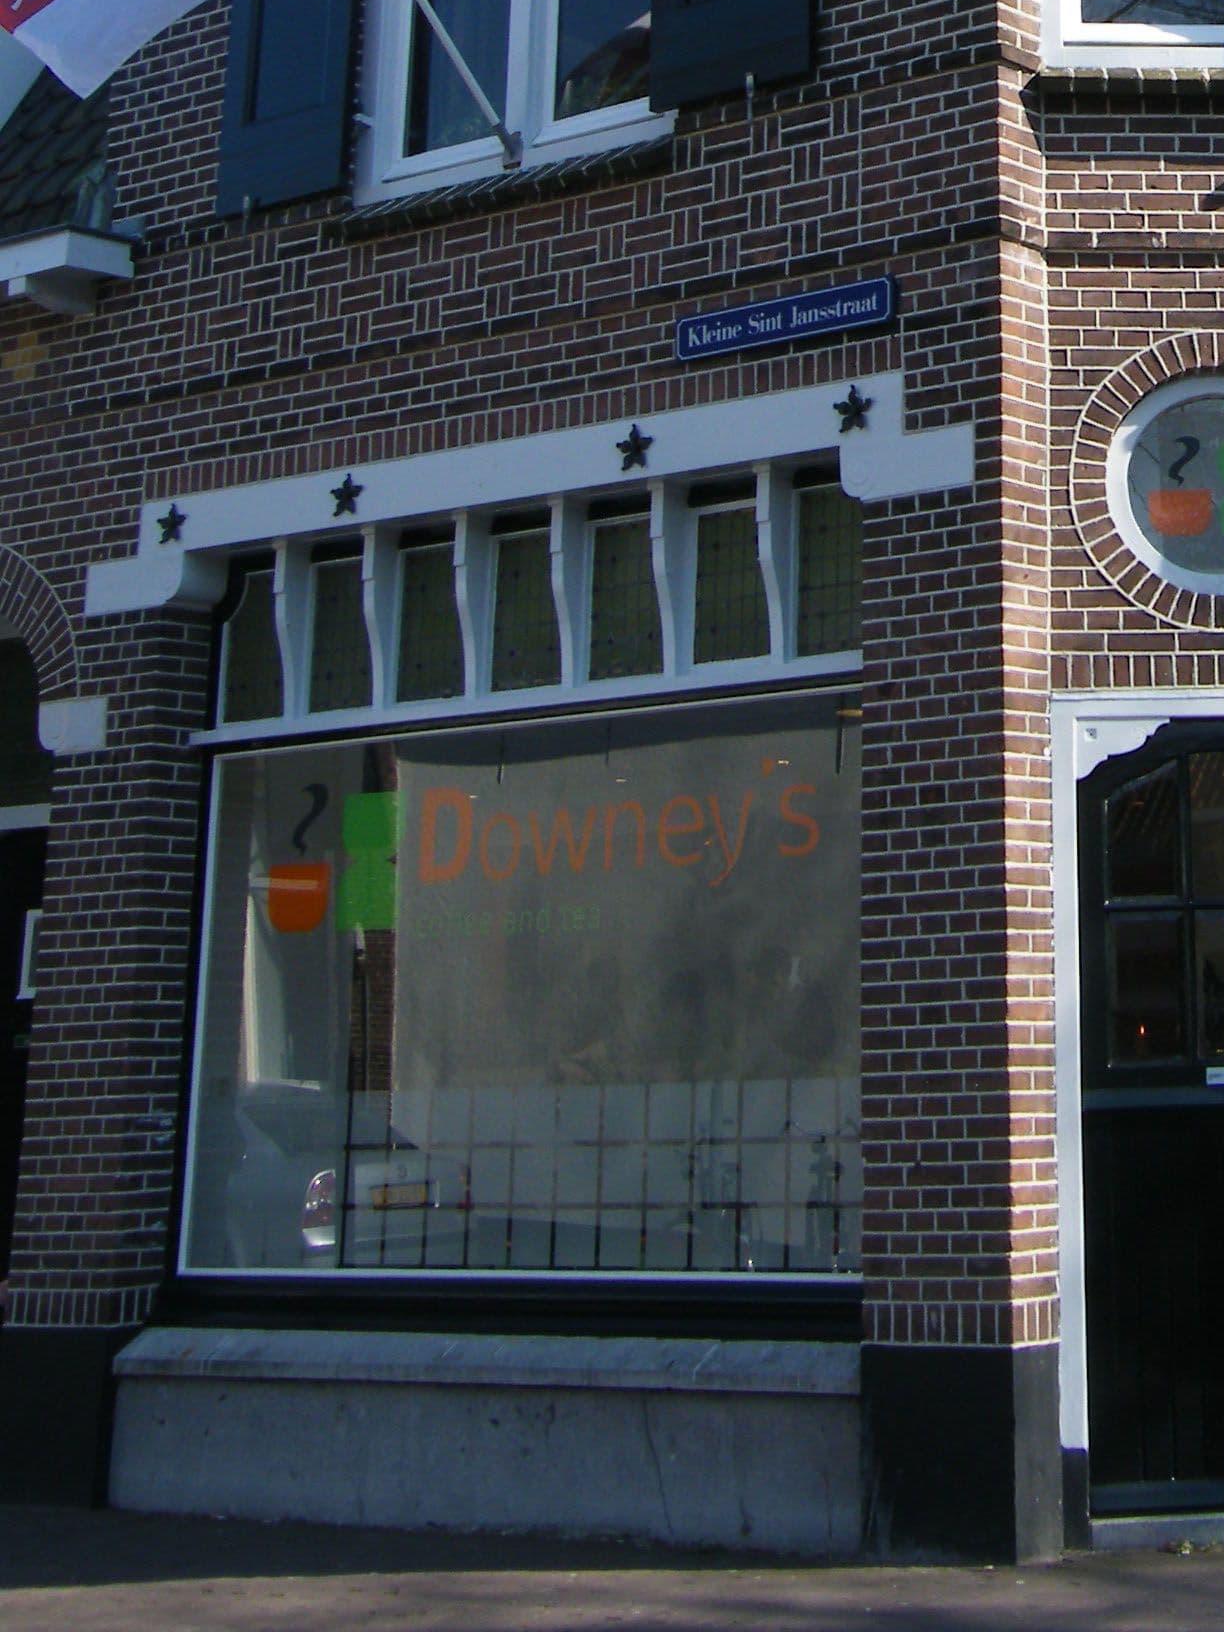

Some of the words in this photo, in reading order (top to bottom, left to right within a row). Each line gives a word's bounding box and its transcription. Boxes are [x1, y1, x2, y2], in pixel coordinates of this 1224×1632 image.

[688, 322, 742, 347] Kleine
[748, 312, 783, 335] Sint
[790, 292, 877, 328] Jansstraat
[418, 758, 821, 887] Downey's
[413, 906, 491, 940] coee
